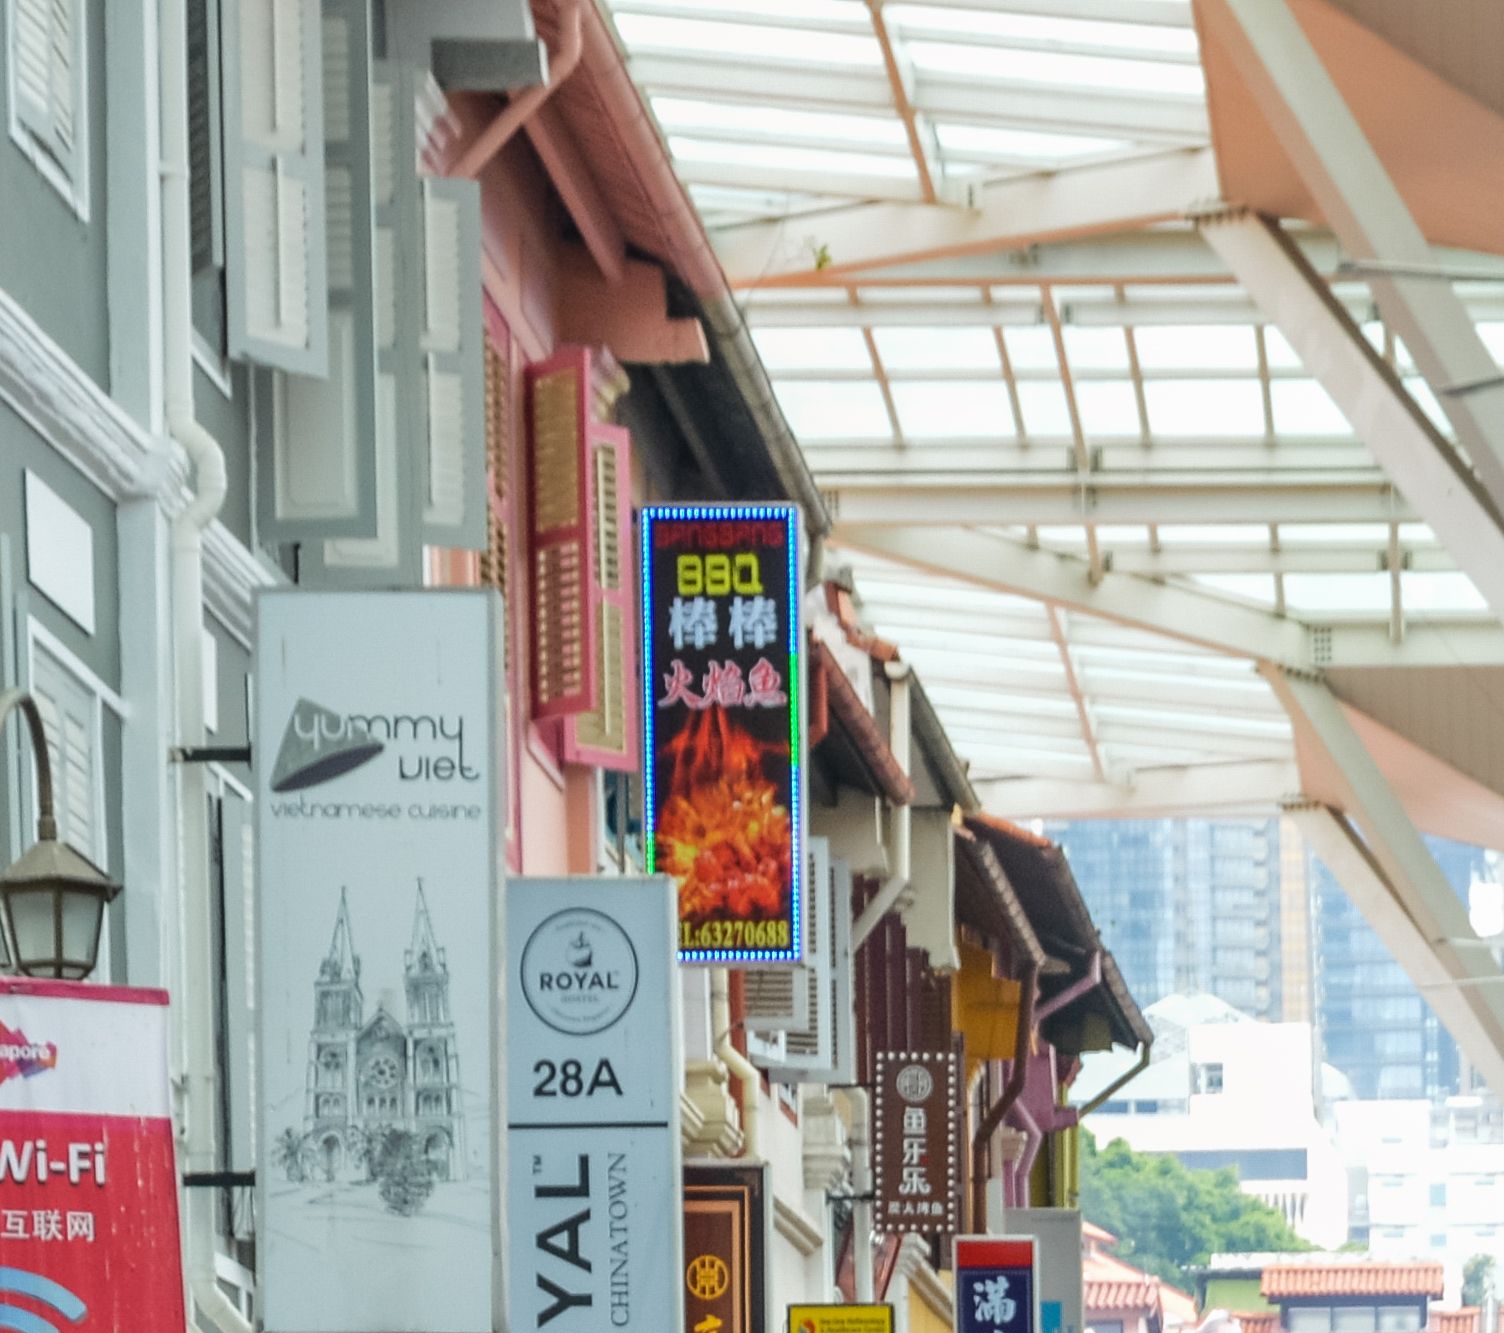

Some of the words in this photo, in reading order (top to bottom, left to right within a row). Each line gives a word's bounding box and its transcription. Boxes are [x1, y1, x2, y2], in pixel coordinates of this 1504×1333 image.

[677, 553, 763, 596] BBQ
[668, 597, 778, 649] 棒棒
[294, 714, 464, 751] yummy
[398, 745, 480, 780] viet
[270, 793, 402, 819] vietnamese
[407, 802, 482, 819] cuisine
[539, 972, 619, 990] ROYAL
[533, 1058, 623, 1098] 28A
[610, 1151, 629, 1324] CHINATOWN
